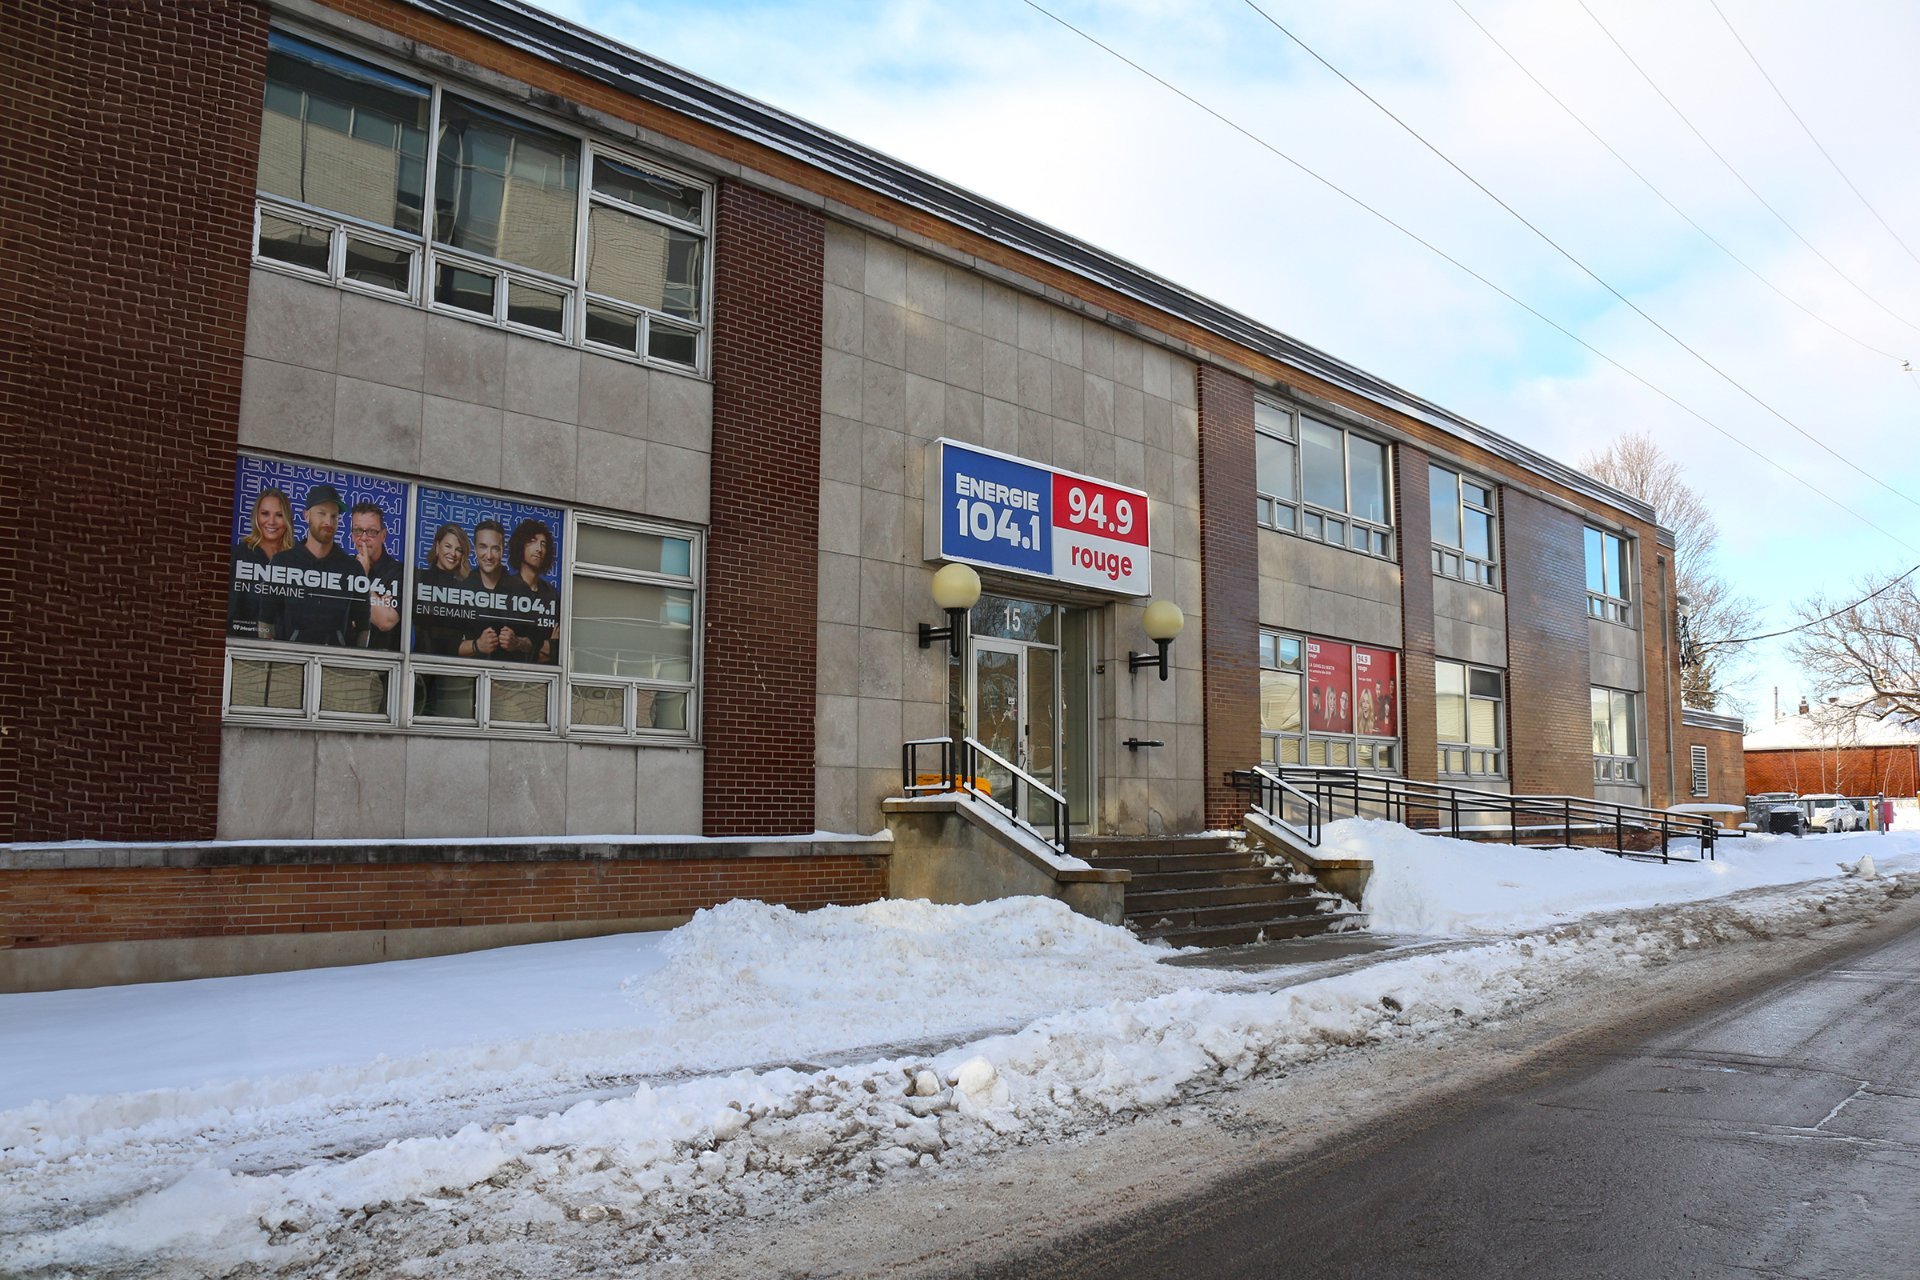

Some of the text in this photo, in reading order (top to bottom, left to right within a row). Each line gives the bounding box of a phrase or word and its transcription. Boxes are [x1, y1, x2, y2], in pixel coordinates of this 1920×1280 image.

[1068, 487, 1133, 535] 94.9
[956, 498, 1041, 552] 104.1
[1071, 545, 1132, 581] rouge
[234, 581, 305, 599] EN SEMAINE
[346, 574, 398, 597] 104.1
[369, 596, 398, 608] 5H30
[416, 604, 477, 620] EN SEMAINE
[511, 595, 556, 616] 104.1
[537, 617, 555, 628] 15H
[1003, 606, 1021, 632] 15
